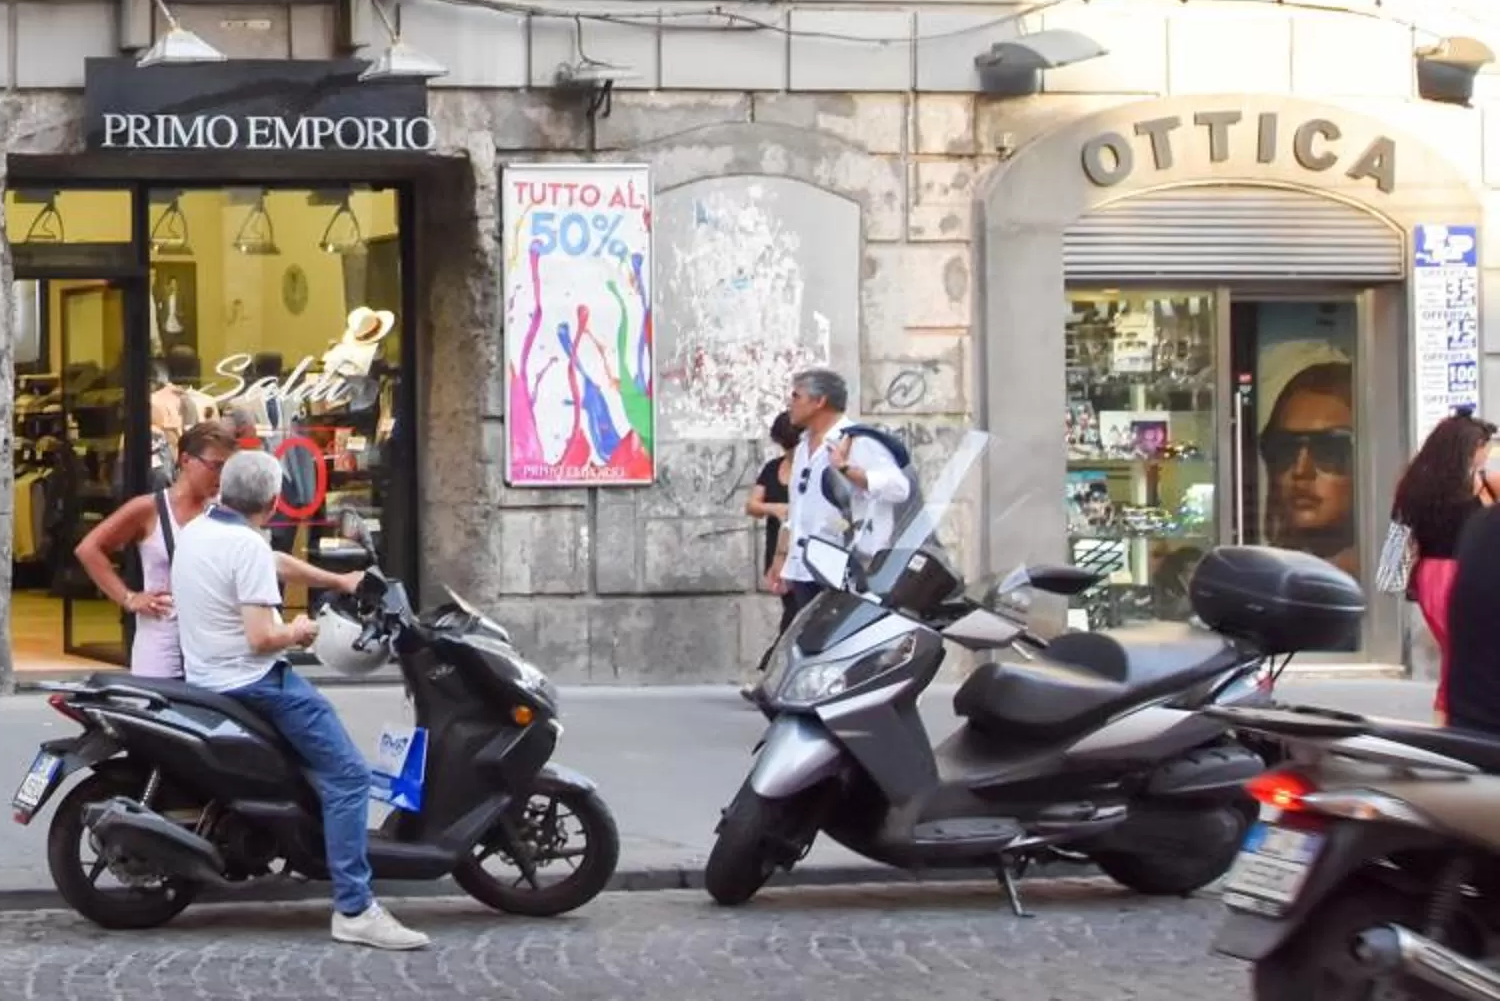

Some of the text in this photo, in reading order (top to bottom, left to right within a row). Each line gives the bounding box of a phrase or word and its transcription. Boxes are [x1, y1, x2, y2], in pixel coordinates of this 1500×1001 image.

[101, 113, 437, 150] PRIMO EMPORIO
[1080, 109, 1397, 195] OTTICA
[514, 180, 643, 209] TUTTO AL
[529, 211, 629, 257] 50%
[192, 353, 352, 407] Saldi
